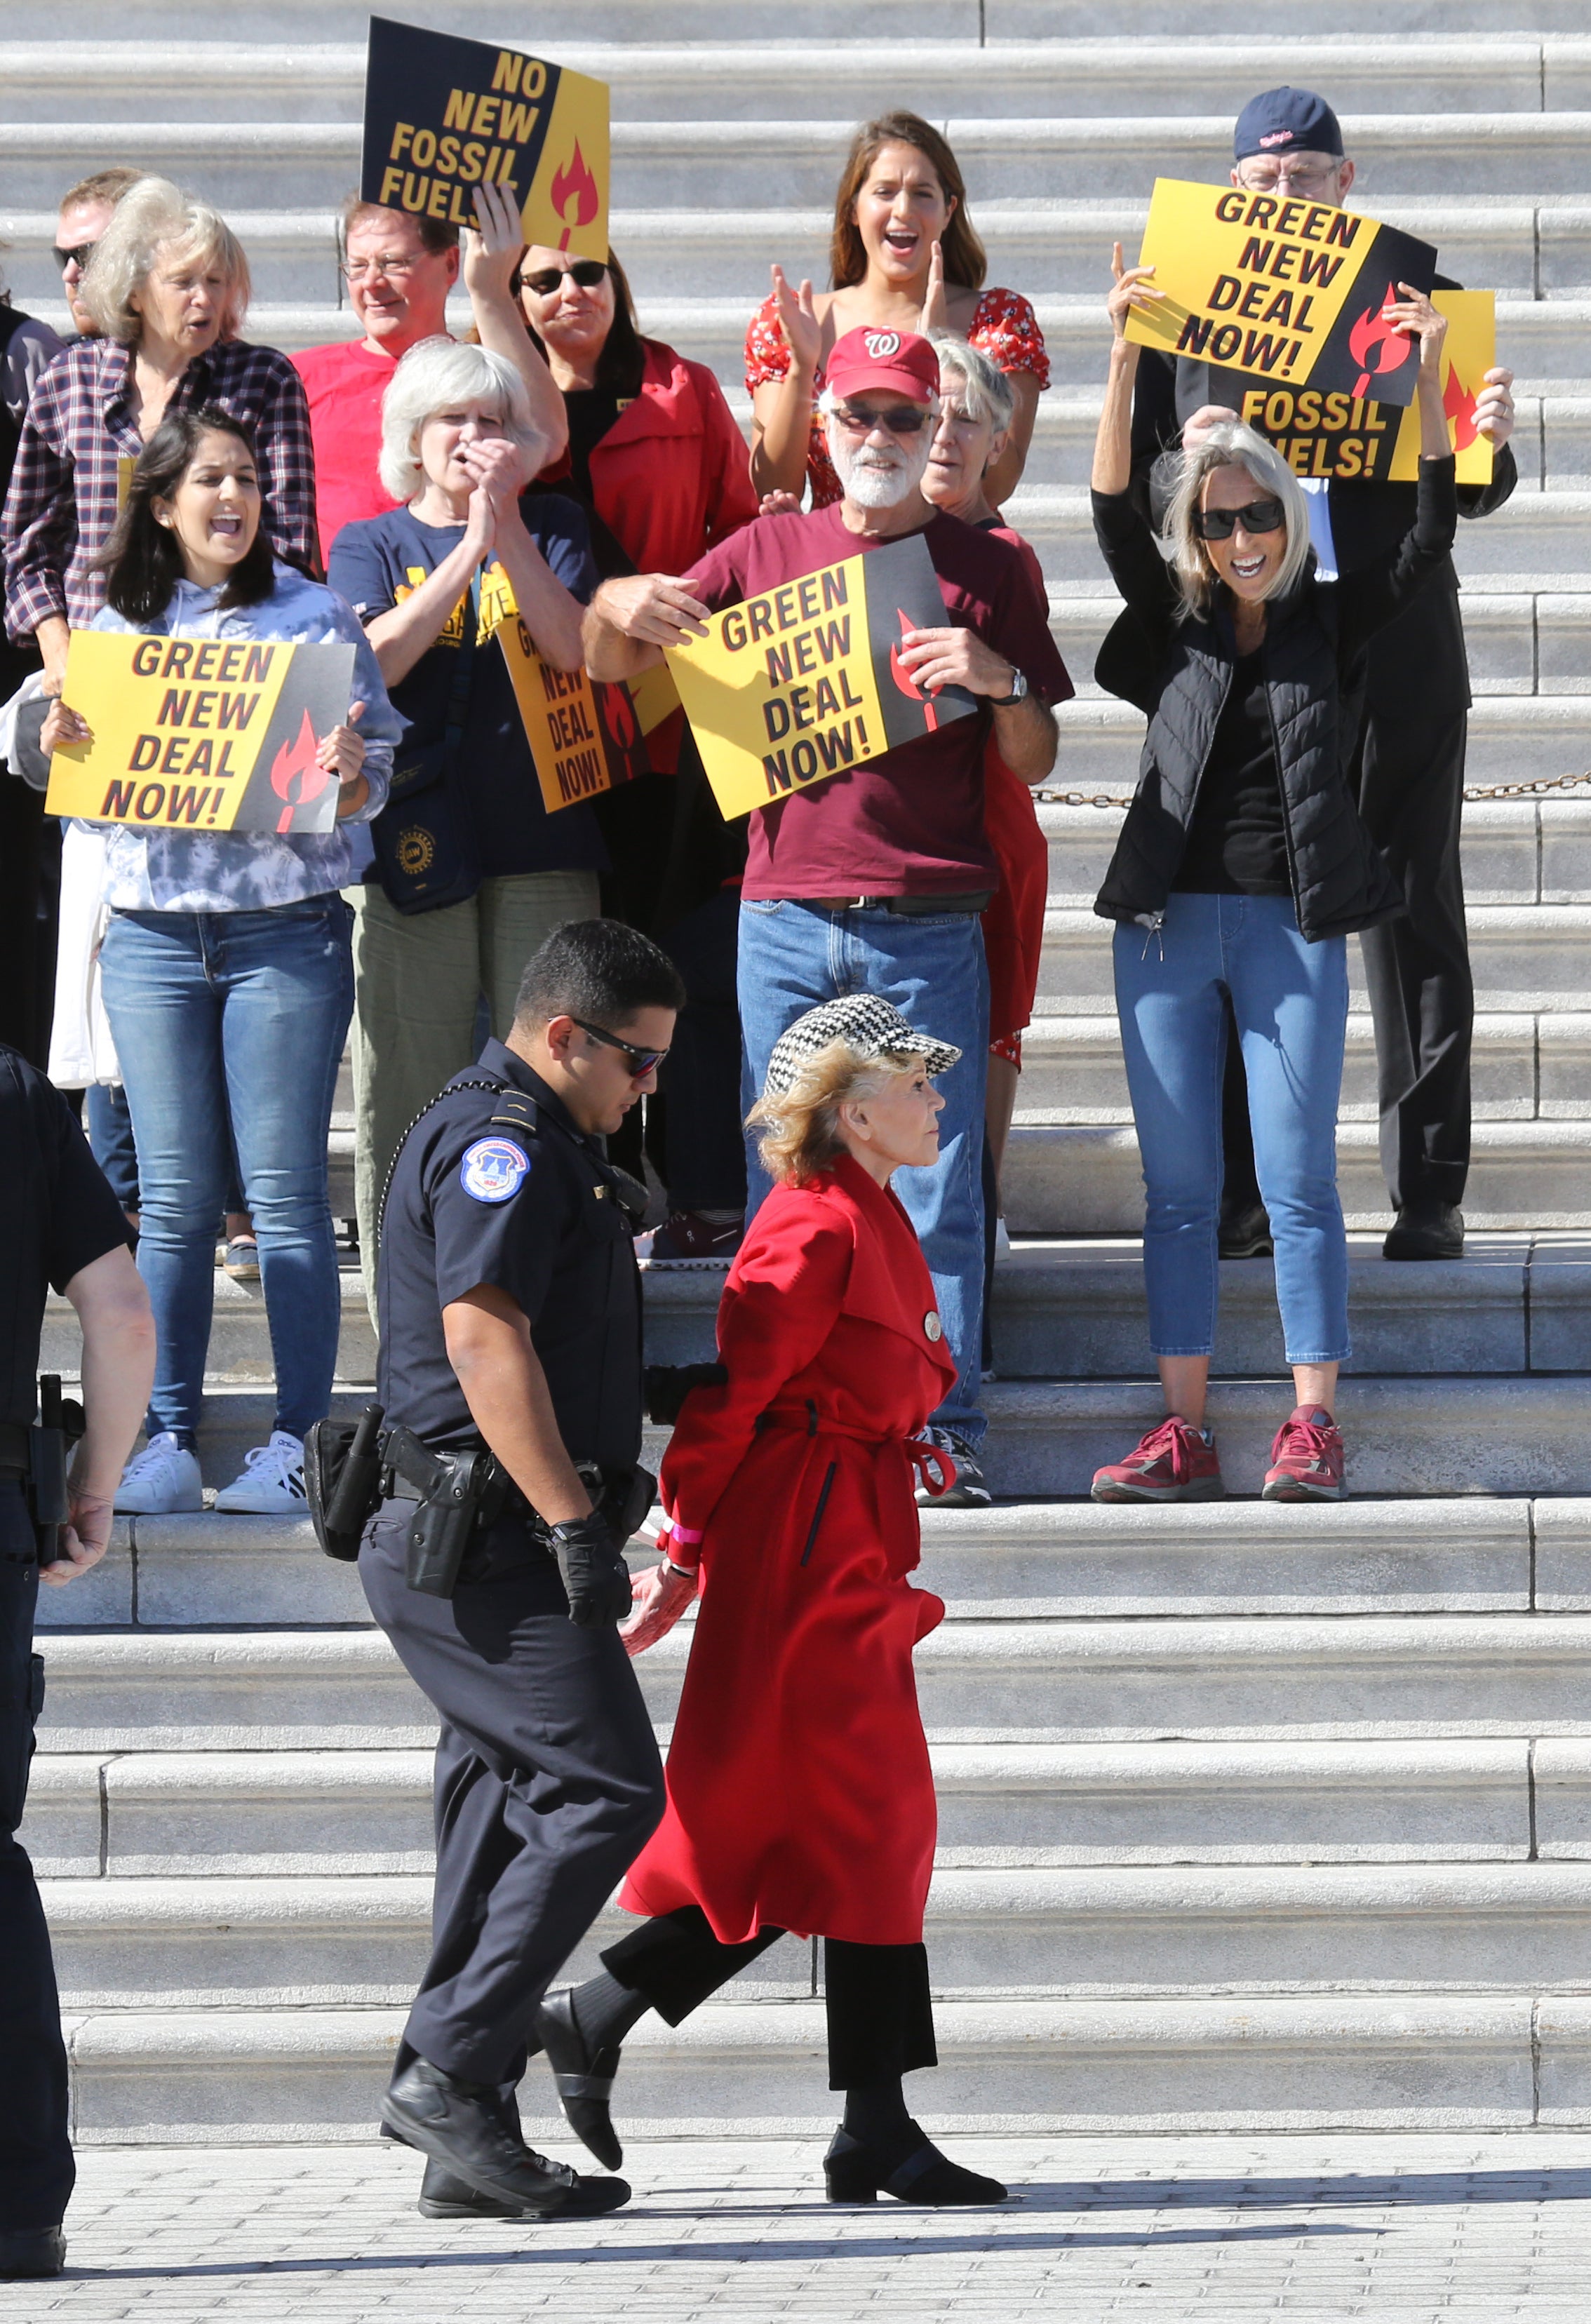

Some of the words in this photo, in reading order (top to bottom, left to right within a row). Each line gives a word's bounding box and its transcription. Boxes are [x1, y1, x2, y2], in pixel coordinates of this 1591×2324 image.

[492, 51, 547, 99] NO
[443, 88, 539, 144] NEW
[389, 122, 518, 190] FOSSIL
[379, 166, 481, 229] FUEL
[1214, 192, 1362, 248] GREEN
[1237, 236, 1345, 288] NEW
[1206, 274, 1315, 333] DEAL
[1176, 314, 1303, 377] NOW!
[1241, 391, 1386, 431] FOSSIL
[721, 565, 848, 652] GREEN
[131, 639, 276, 683] GREEN
[765, 614, 851, 689] NEW
[156, 688, 261, 730] NEW
[539, 663, 582, 702] NEW
[763, 668, 863, 743] DEAL
[546, 701, 593, 752] DEAL
[127, 734, 235, 777] DEAL
[555, 748, 603, 802] NOW!
[763, 715, 871, 797] NOW!
[100, 779, 225, 825] NOW!
